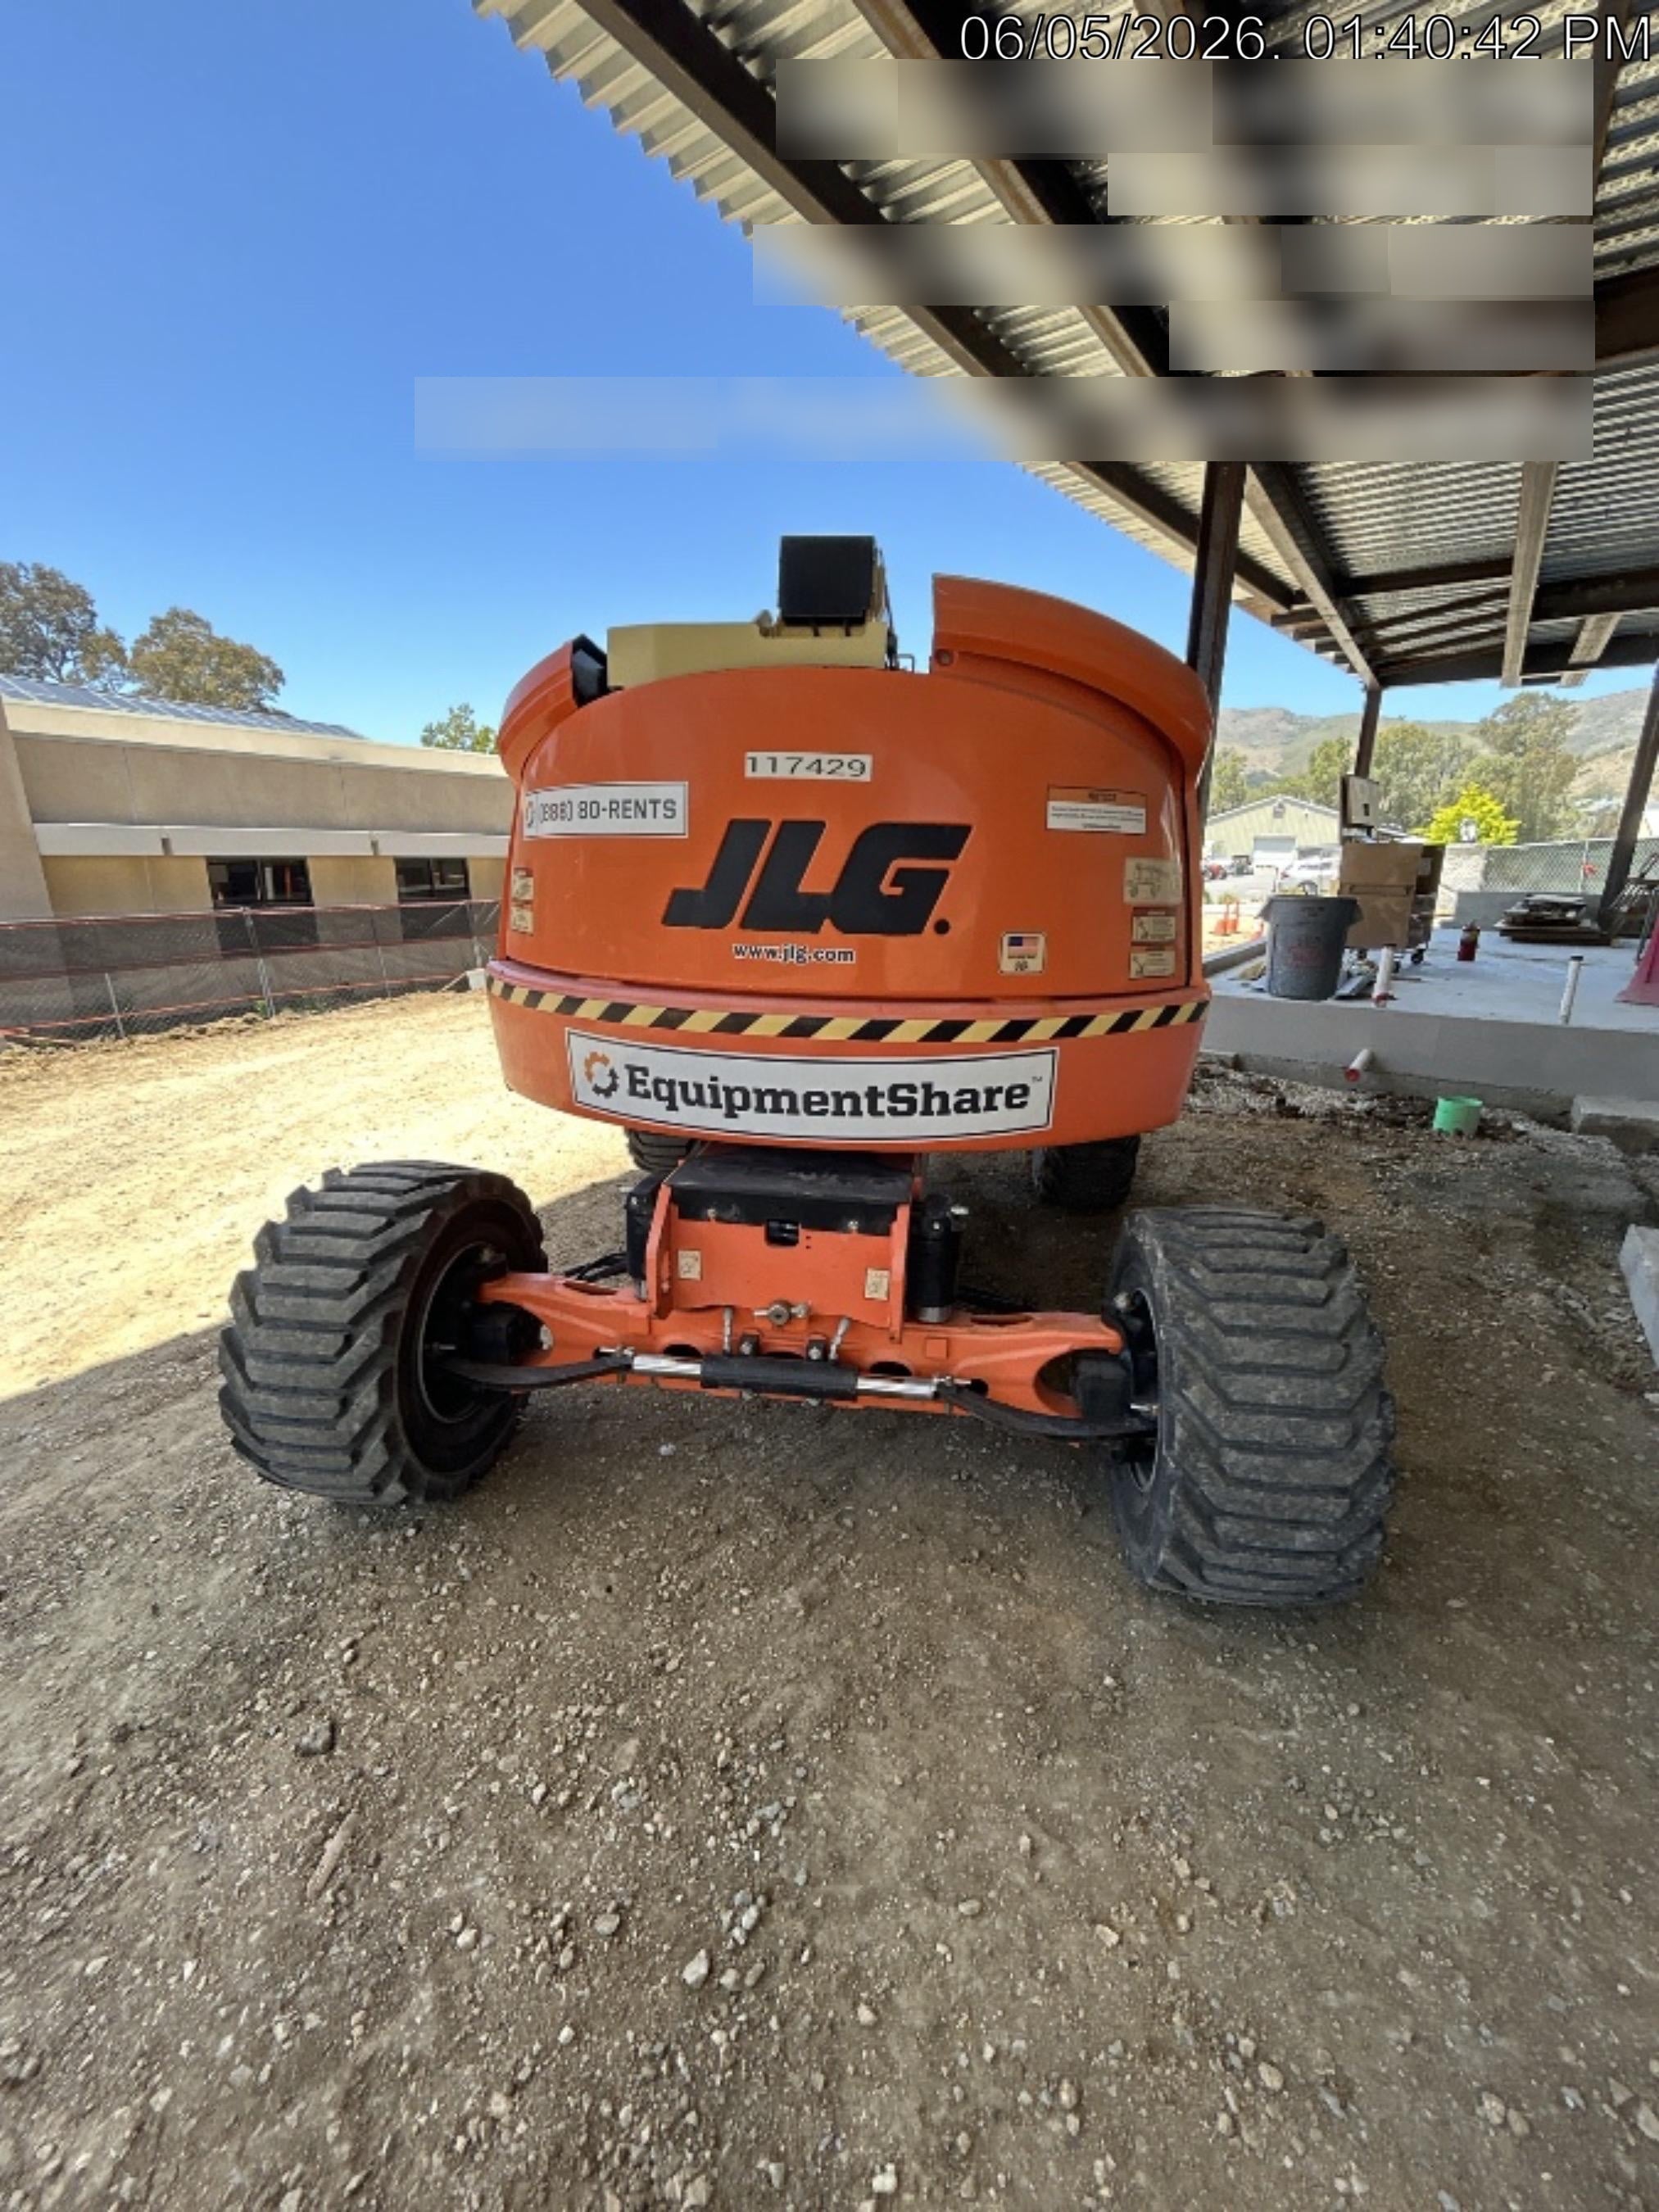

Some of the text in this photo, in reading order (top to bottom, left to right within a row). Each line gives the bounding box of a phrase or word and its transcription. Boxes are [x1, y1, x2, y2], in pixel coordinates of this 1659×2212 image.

[746, 756, 866, 777] 117429
[577, 798, 678, 820] 80-RENTS
[733, 945, 854, 963] www.jlg.com
